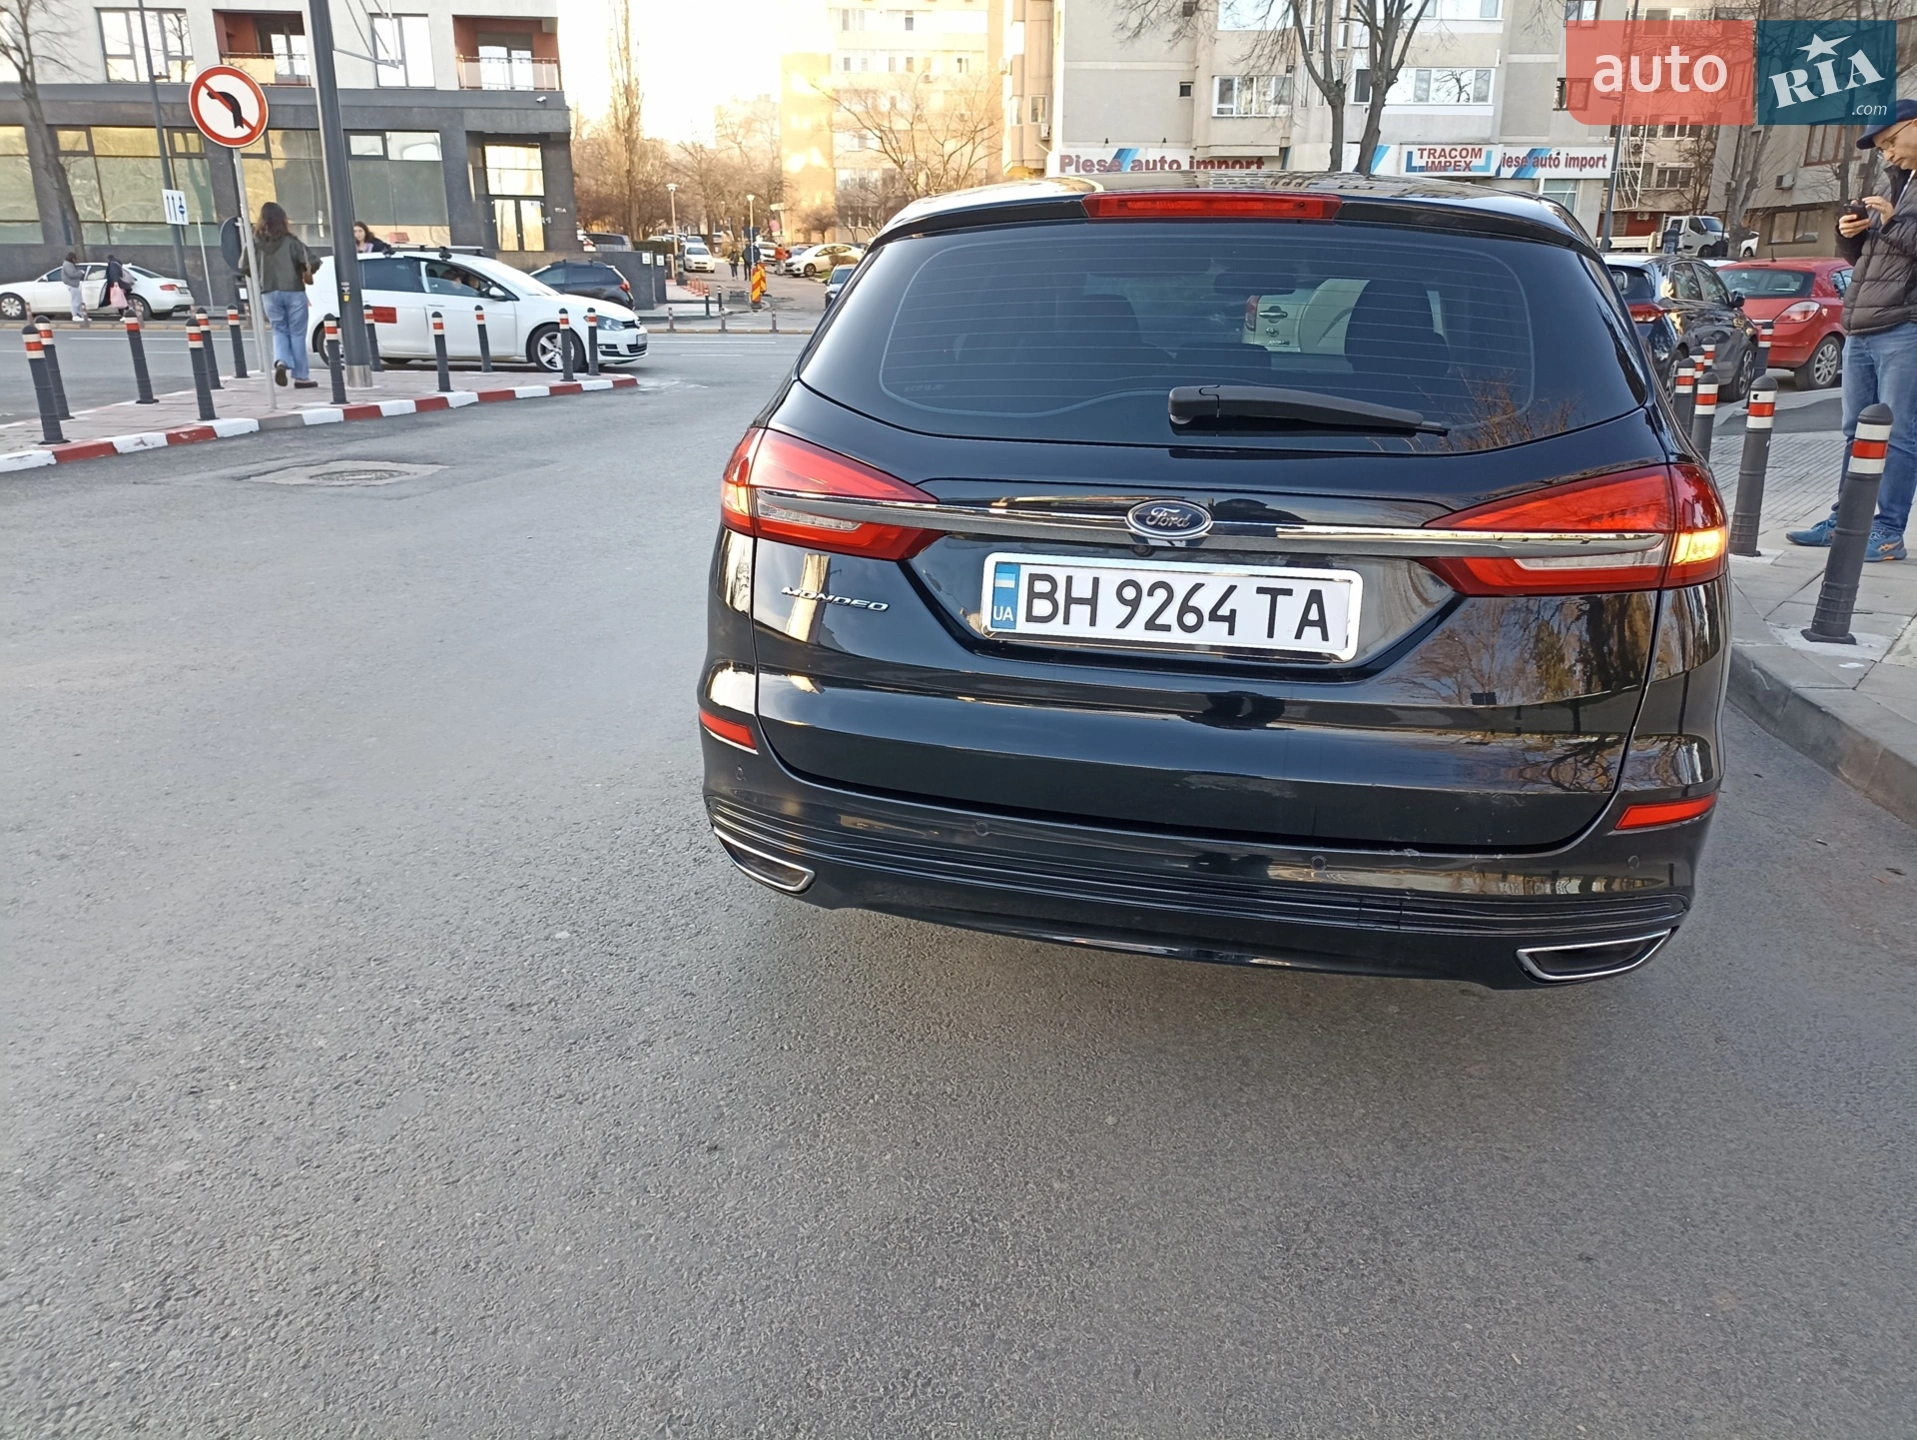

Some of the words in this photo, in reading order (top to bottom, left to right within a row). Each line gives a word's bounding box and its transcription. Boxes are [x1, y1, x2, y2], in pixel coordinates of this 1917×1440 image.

[1417, 147, 1483, 159] TRACOM
[1502, 152, 1528, 169] iese
[1532, 154, 1560, 169] auto
[1565, 153, 1607, 174] import
[1059, 154, 1123, 173] Piese
[1130, 155, 1181, 171] auto
[1425, 160, 1473, 172] IMPEX
[1145, 506, 1192, 528] Ford
[781, 586, 890, 612] MONDEO
[1025, 572, 1099, 627] BH
[1115, 578, 1238, 636] 9264
[1256, 586, 1329, 642] TA
[993, 605, 1014, 622] UA
